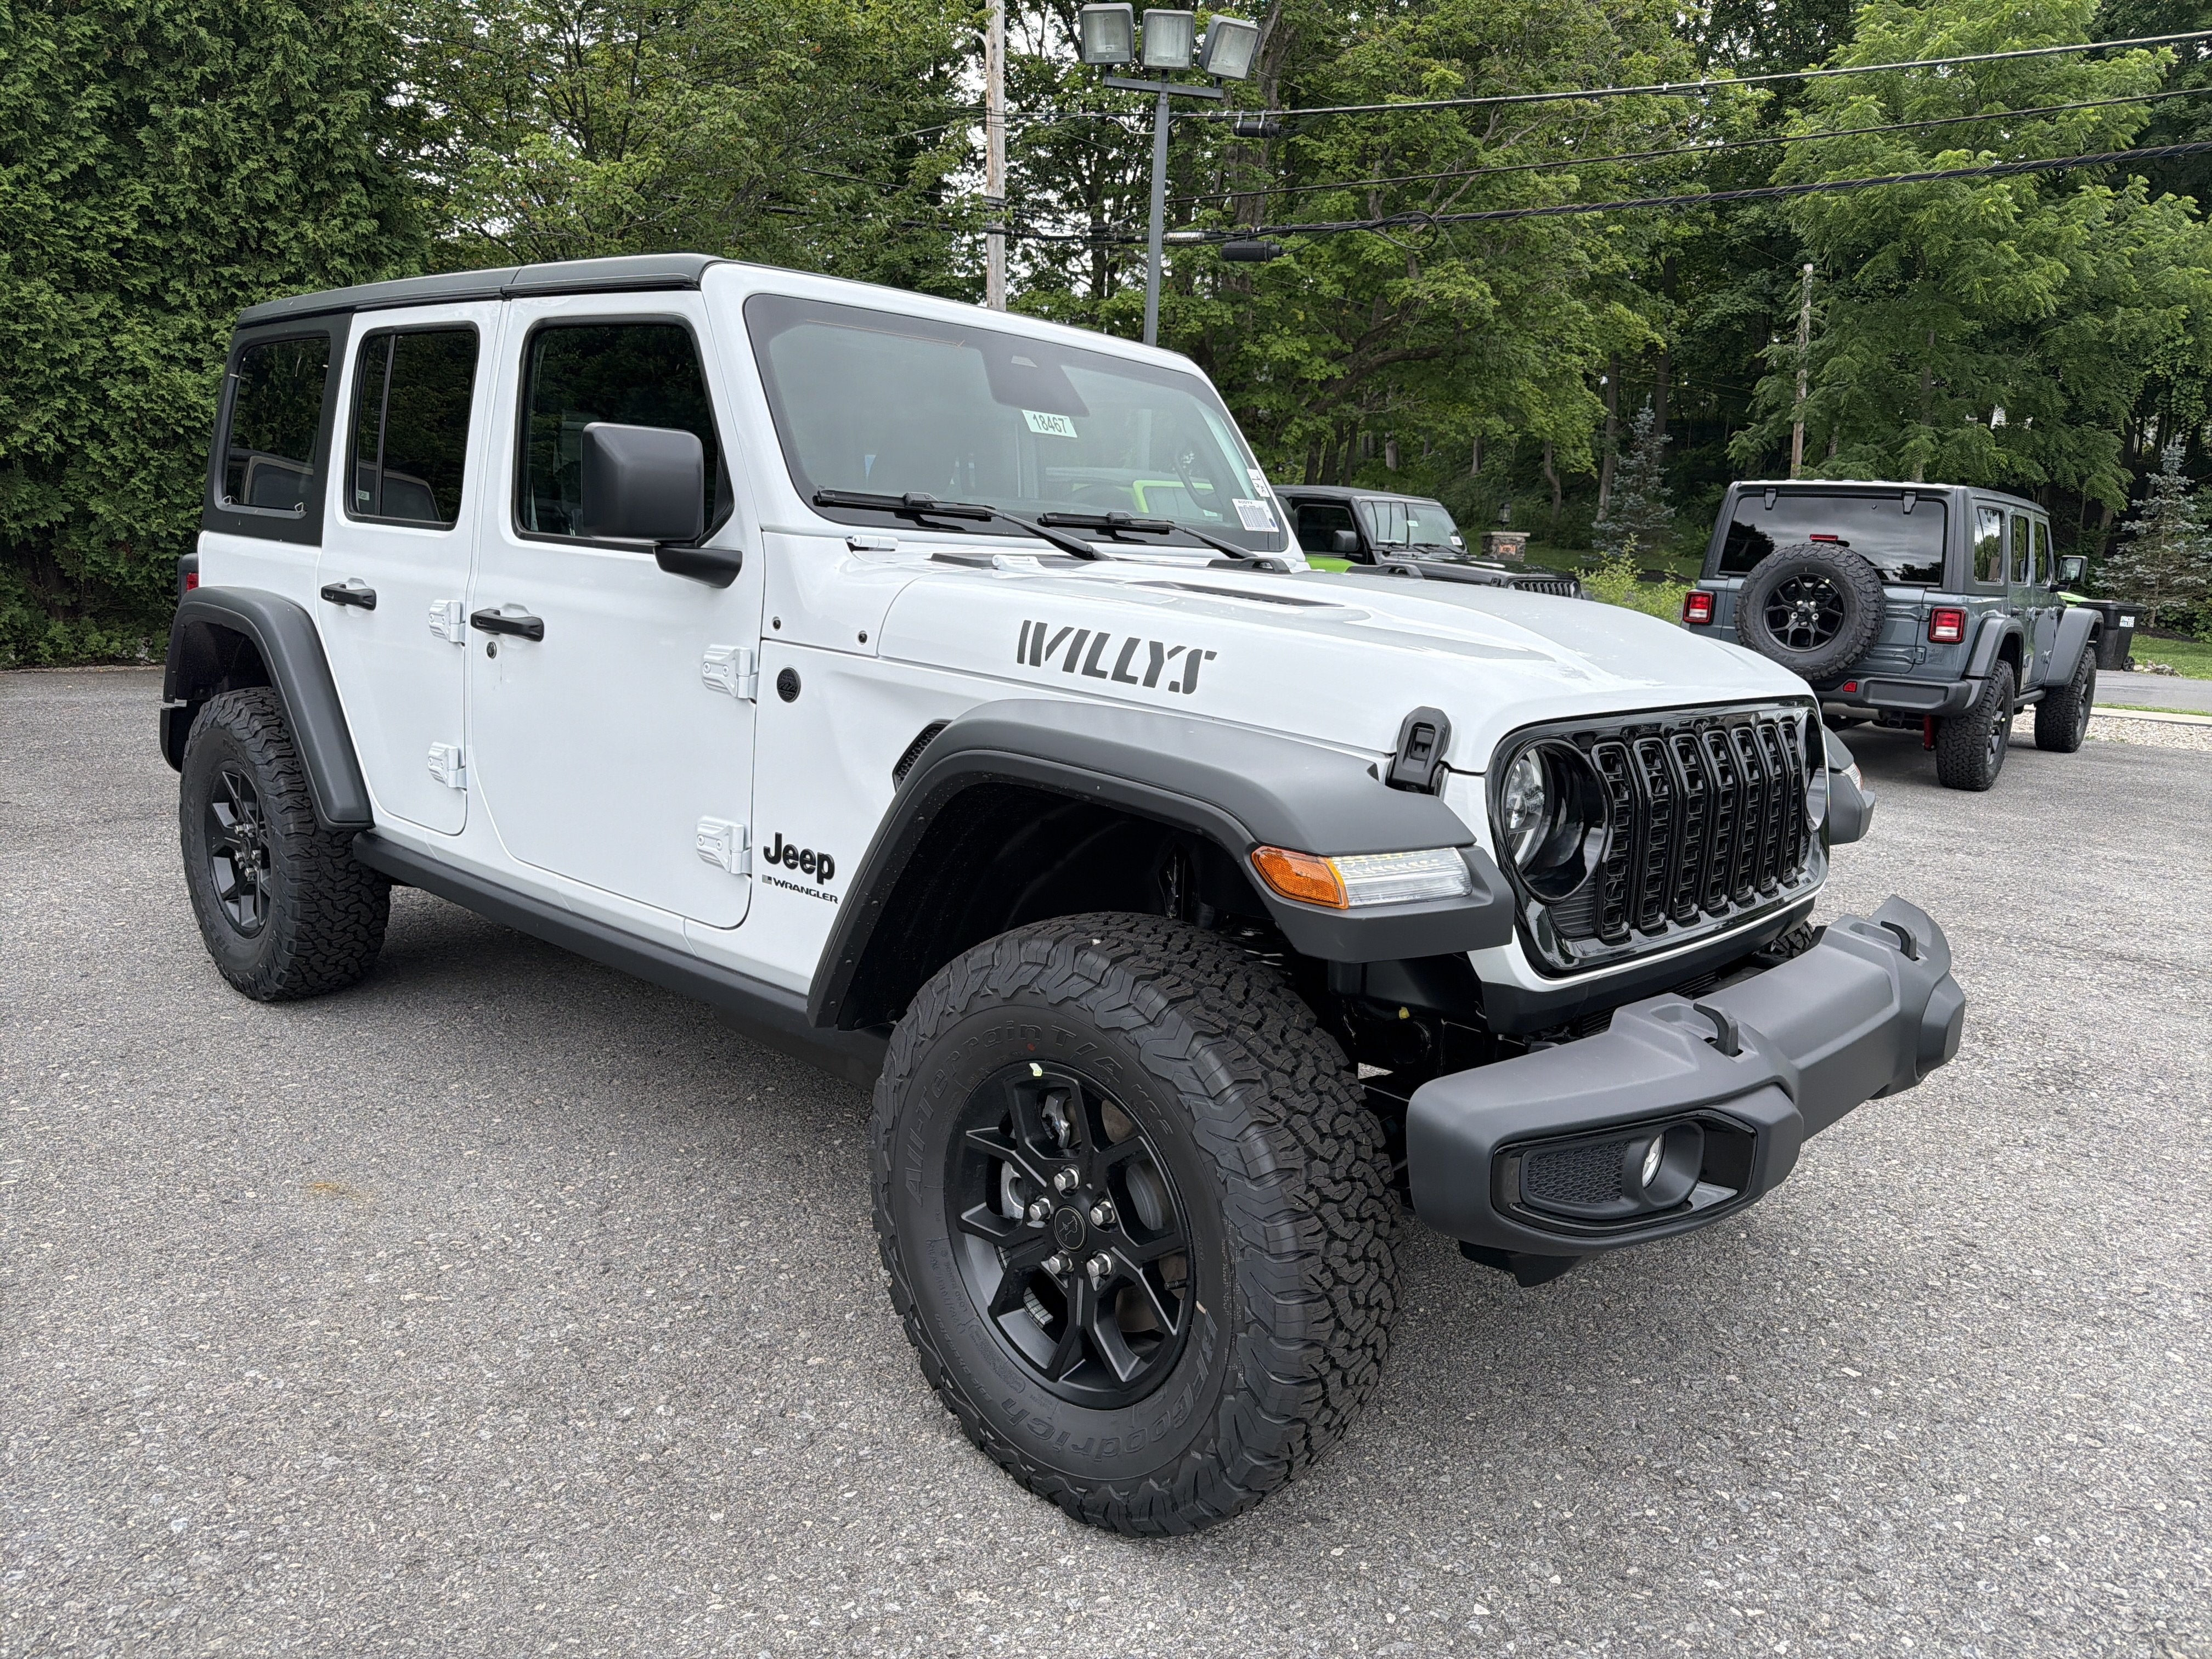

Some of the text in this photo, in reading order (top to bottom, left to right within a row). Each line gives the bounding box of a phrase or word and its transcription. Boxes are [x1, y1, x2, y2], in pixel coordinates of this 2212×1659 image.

[1033, 414, 1067, 433] 18467
[1017, 619, 1218, 695] WILLYS
[763, 832, 835, 885] Jeep
[772, 877, 838, 904] WRANGLER
[905, 1020, 1043, 1206] All-Terrain
[1051, 1025, 1124, 1084] T/A
[1000, 1308, 1218, 1462] BFGoodrich
